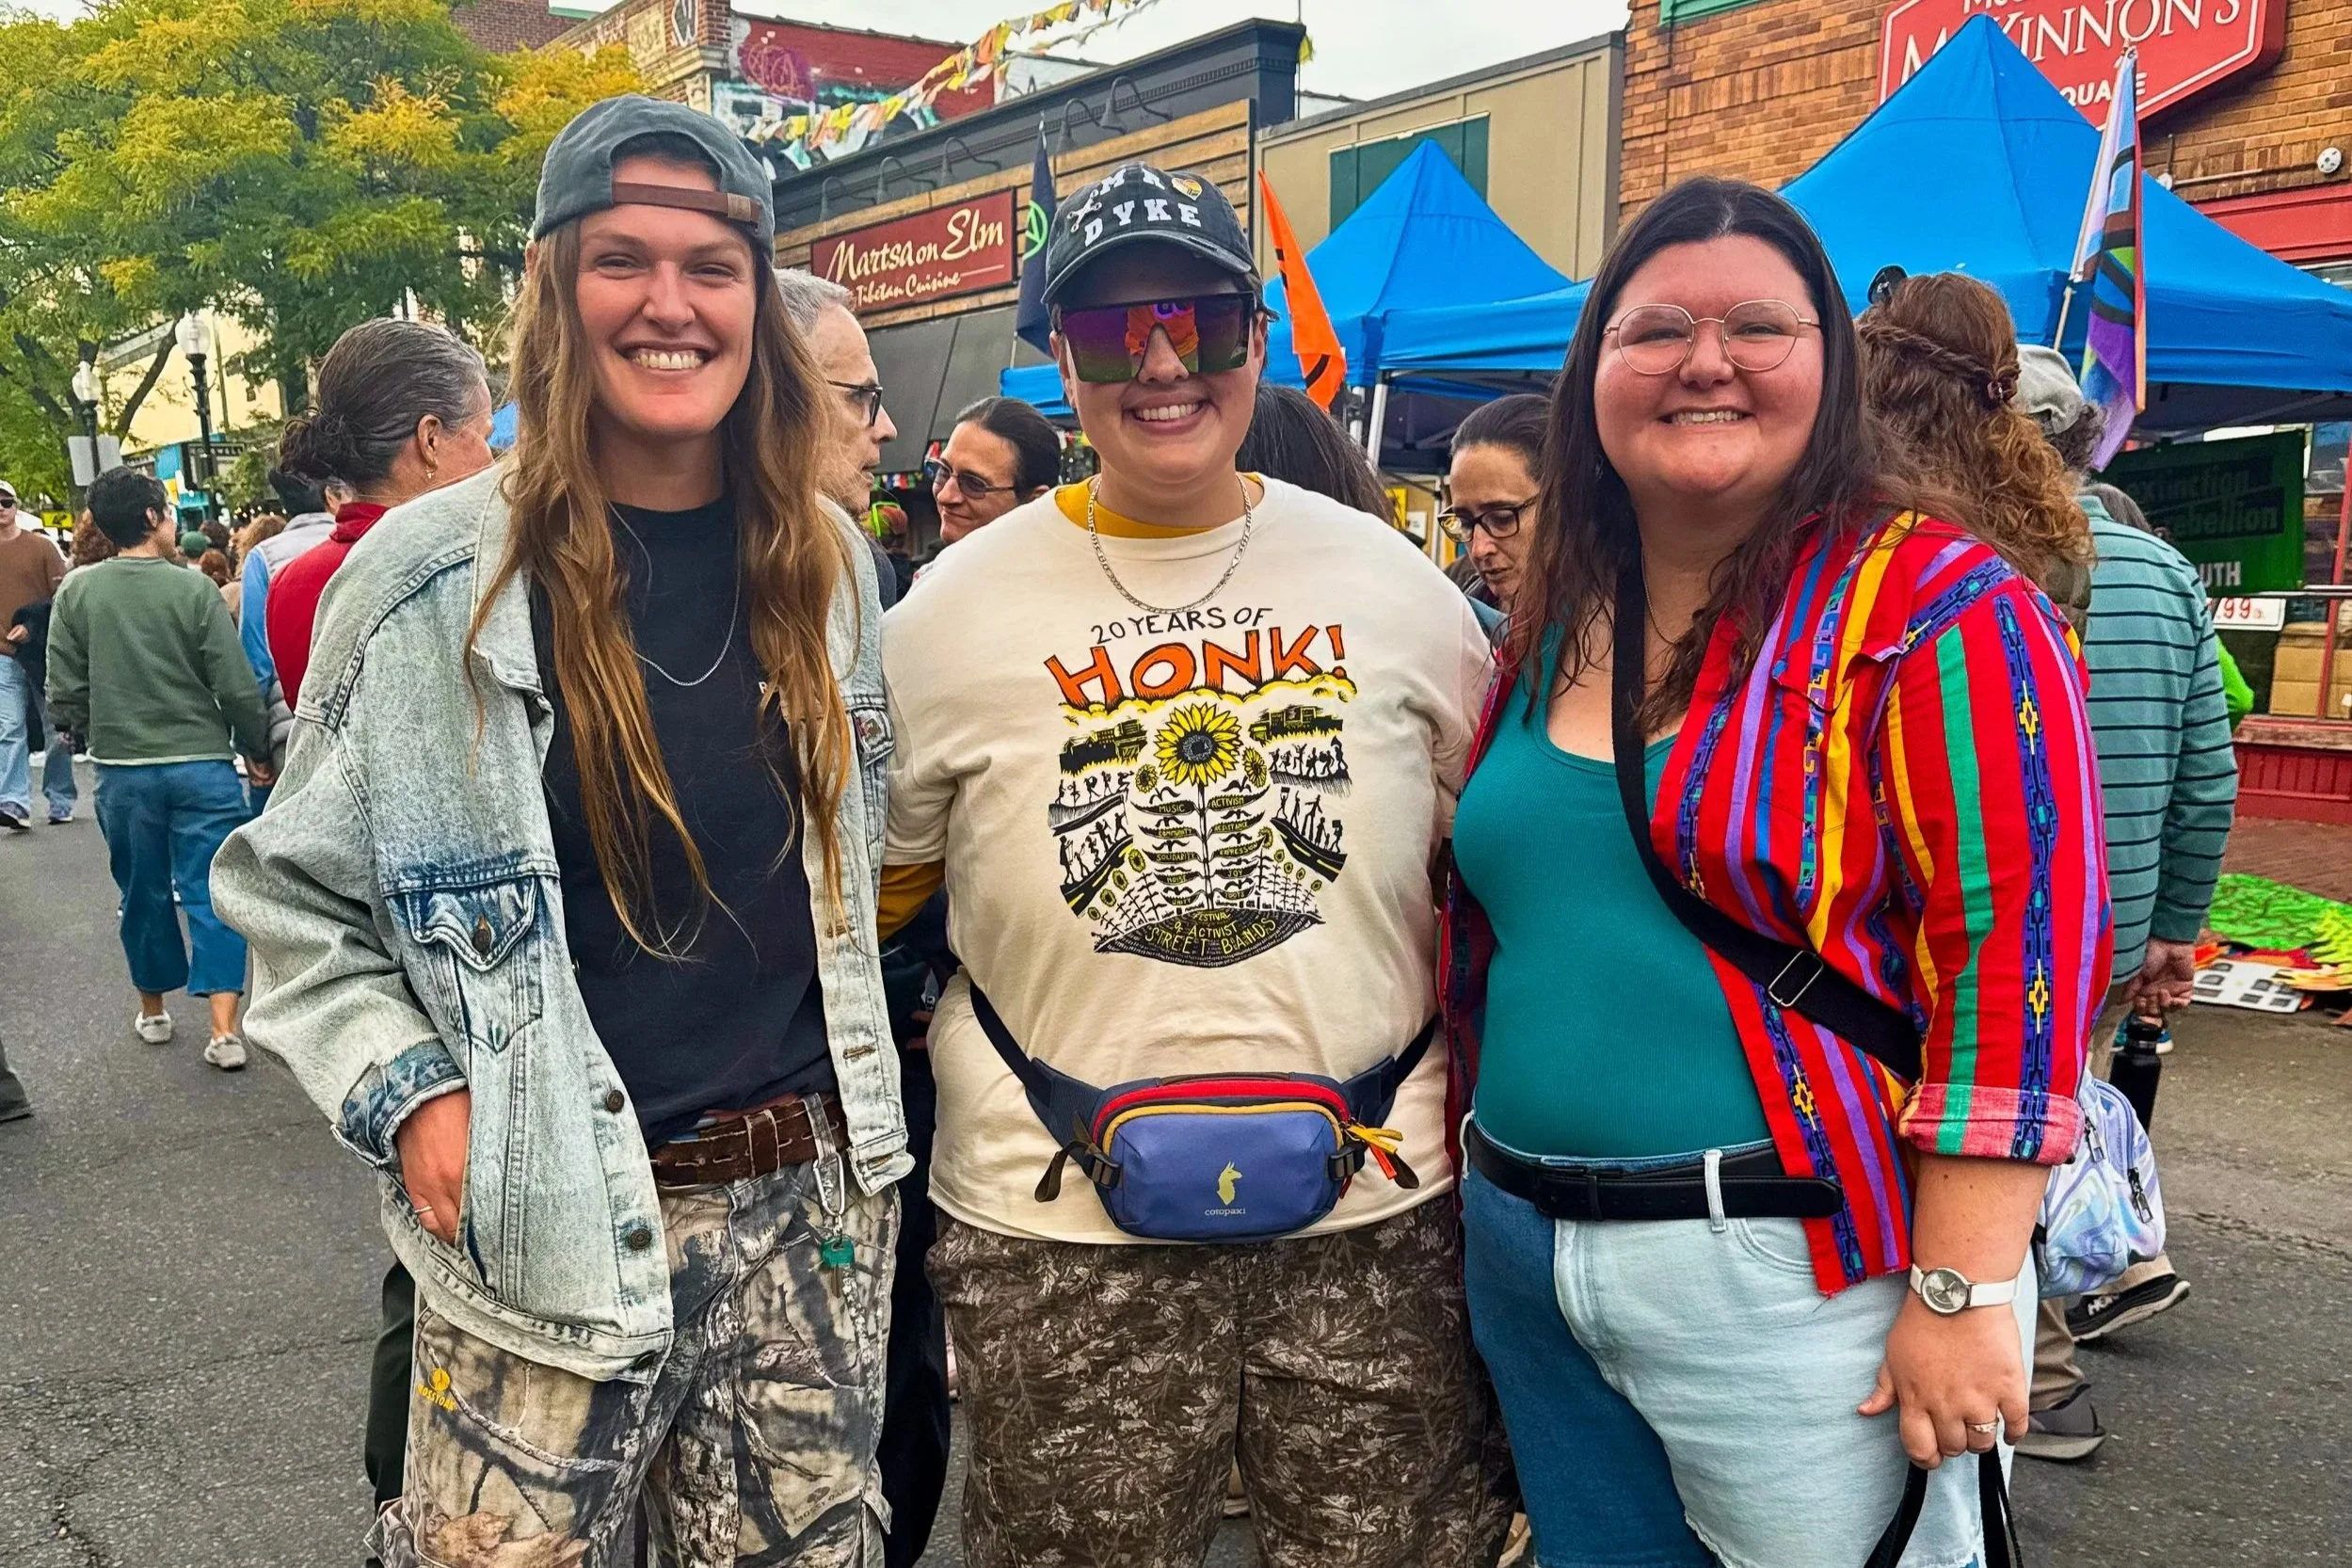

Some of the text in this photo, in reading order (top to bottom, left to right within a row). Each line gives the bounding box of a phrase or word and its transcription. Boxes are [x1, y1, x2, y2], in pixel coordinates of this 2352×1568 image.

[1899, 0, 2241, 86] MINNONS
[2059, 72, 2148, 106] QUAE
[1084, 199, 1202, 247] DYKE
[826, 208, 1004, 283] Martsa on Elm
[856, 272, 961, 306] Tibetan Cuisine
[2126, 464, 2249, 502] extinction
[2199, 561, 2241, 587] UTH
[1091, 607, 1272, 645] 20 YEARS OF
[1044, 624, 1347, 712] HONK!
[1159, 804, 1185, 813] MUSIC
[1211, 795, 1244, 808] ACTIVISM
[1156, 852, 1195, 861] SOLIDARITY
[1227, 869, 1243, 877] JOY
[1189, 920, 1238, 938] ACTIVIST
[1194, 912, 1231, 922] FESTIVAL
[1145, 917, 1276, 956] STREET BANDS
[1205, 1208, 1246, 1217] cotopaxi
